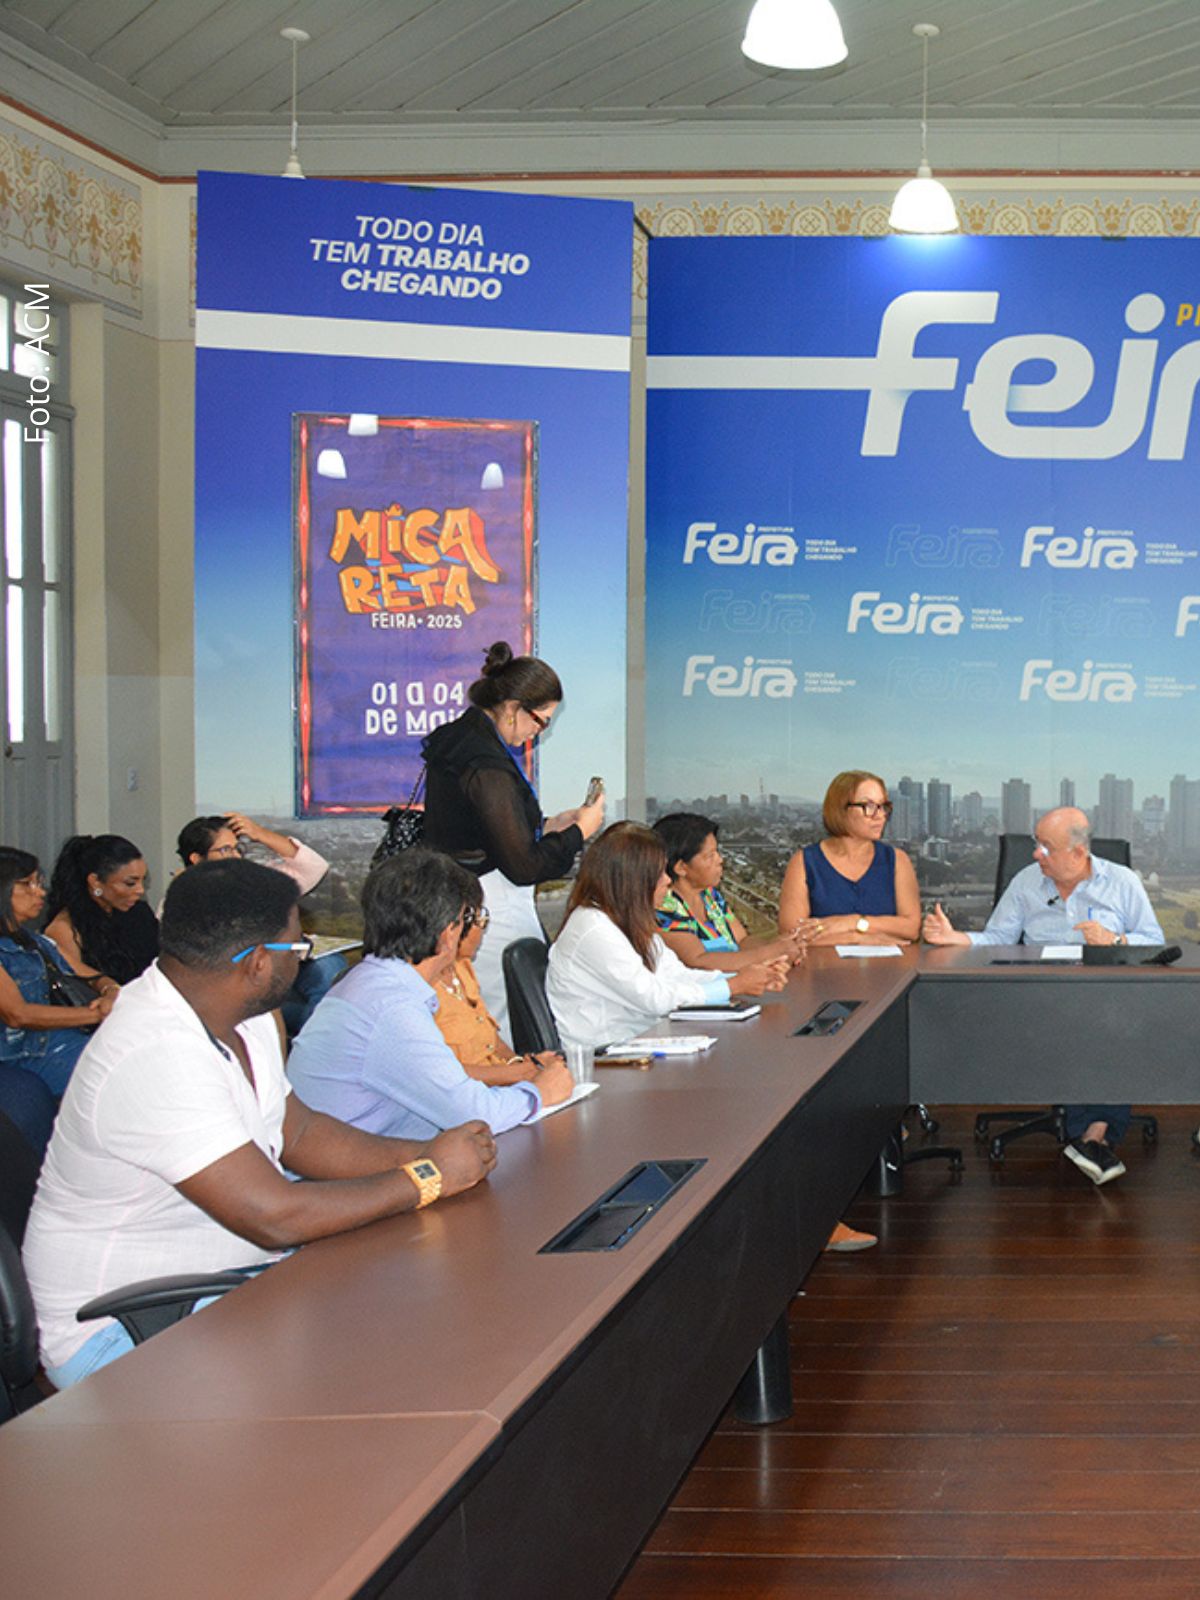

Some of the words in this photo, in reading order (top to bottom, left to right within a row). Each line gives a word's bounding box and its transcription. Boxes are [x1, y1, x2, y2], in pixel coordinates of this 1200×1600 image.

[355, 215, 434, 243] TODO
[438, 222, 485, 247] DIA
[309, 238, 371, 264] TEM
[376, 243, 531, 276] TRABALHO
[340, 268, 503, 300] CHEGANDO
[683, 522, 799, 566] Feira
[1020, 526, 1139, 569] Feira
[338, 564, 477, 616] RETA
[427, 614, 463, 629] 2025
[847, 592, 964, 635] Feira
[371, 681, 398, 705] 01
[433, 681, 465, 706] 04
[682, 655, 798, 698] Feira
[1020, 659, 1137, 703] Feira
